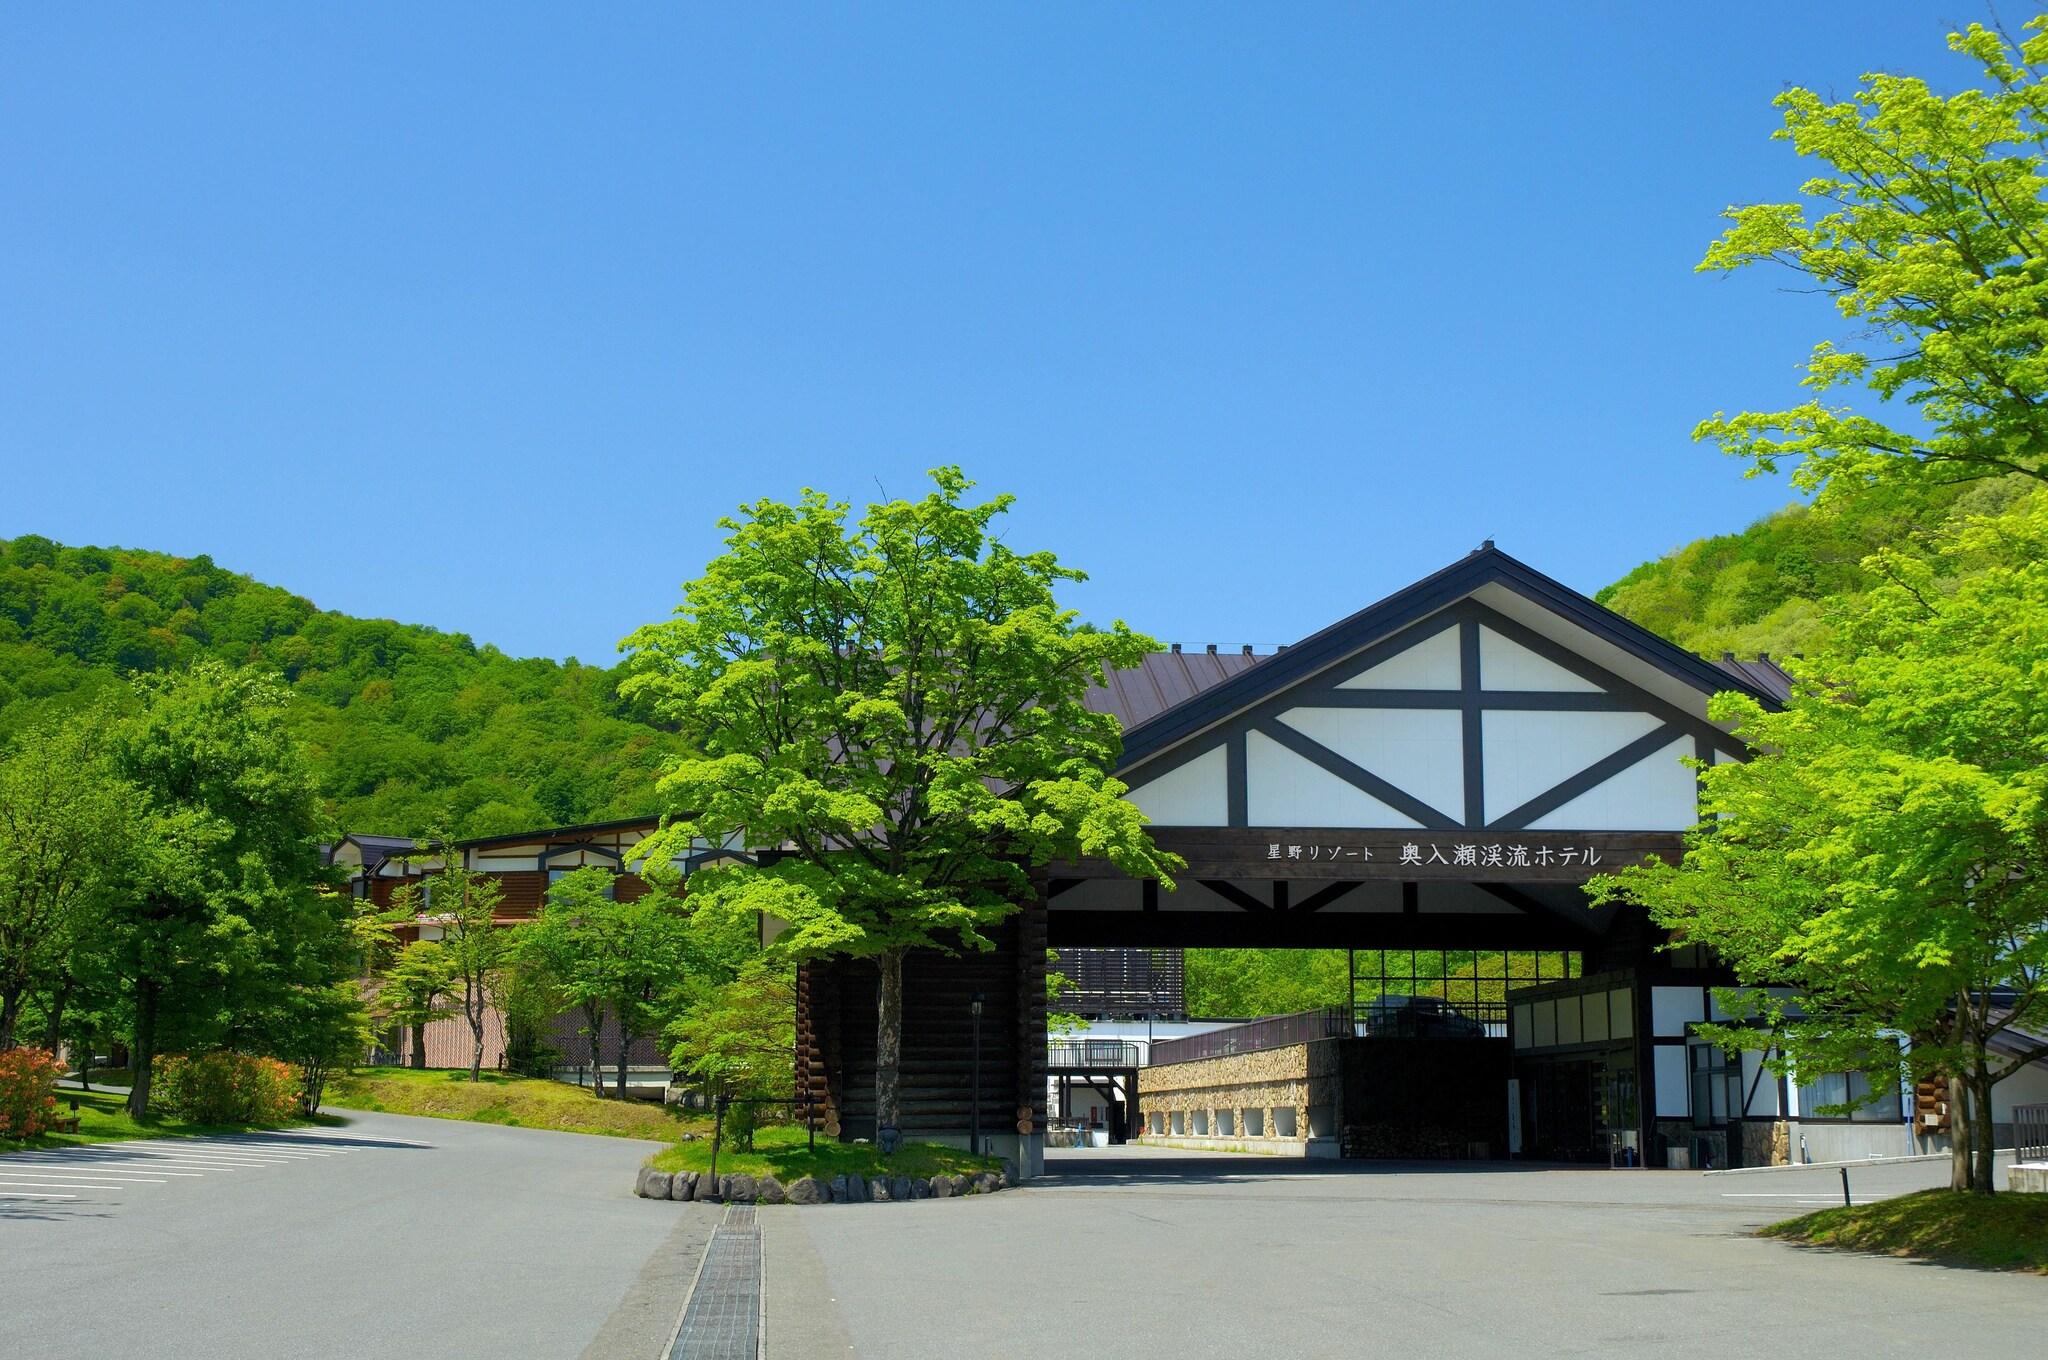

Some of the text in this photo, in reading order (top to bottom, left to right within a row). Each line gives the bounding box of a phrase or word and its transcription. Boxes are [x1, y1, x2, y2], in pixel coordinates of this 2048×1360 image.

[1267, 841, 1602, 868] 星野リゾート 奥入瀬渓流ホテル
